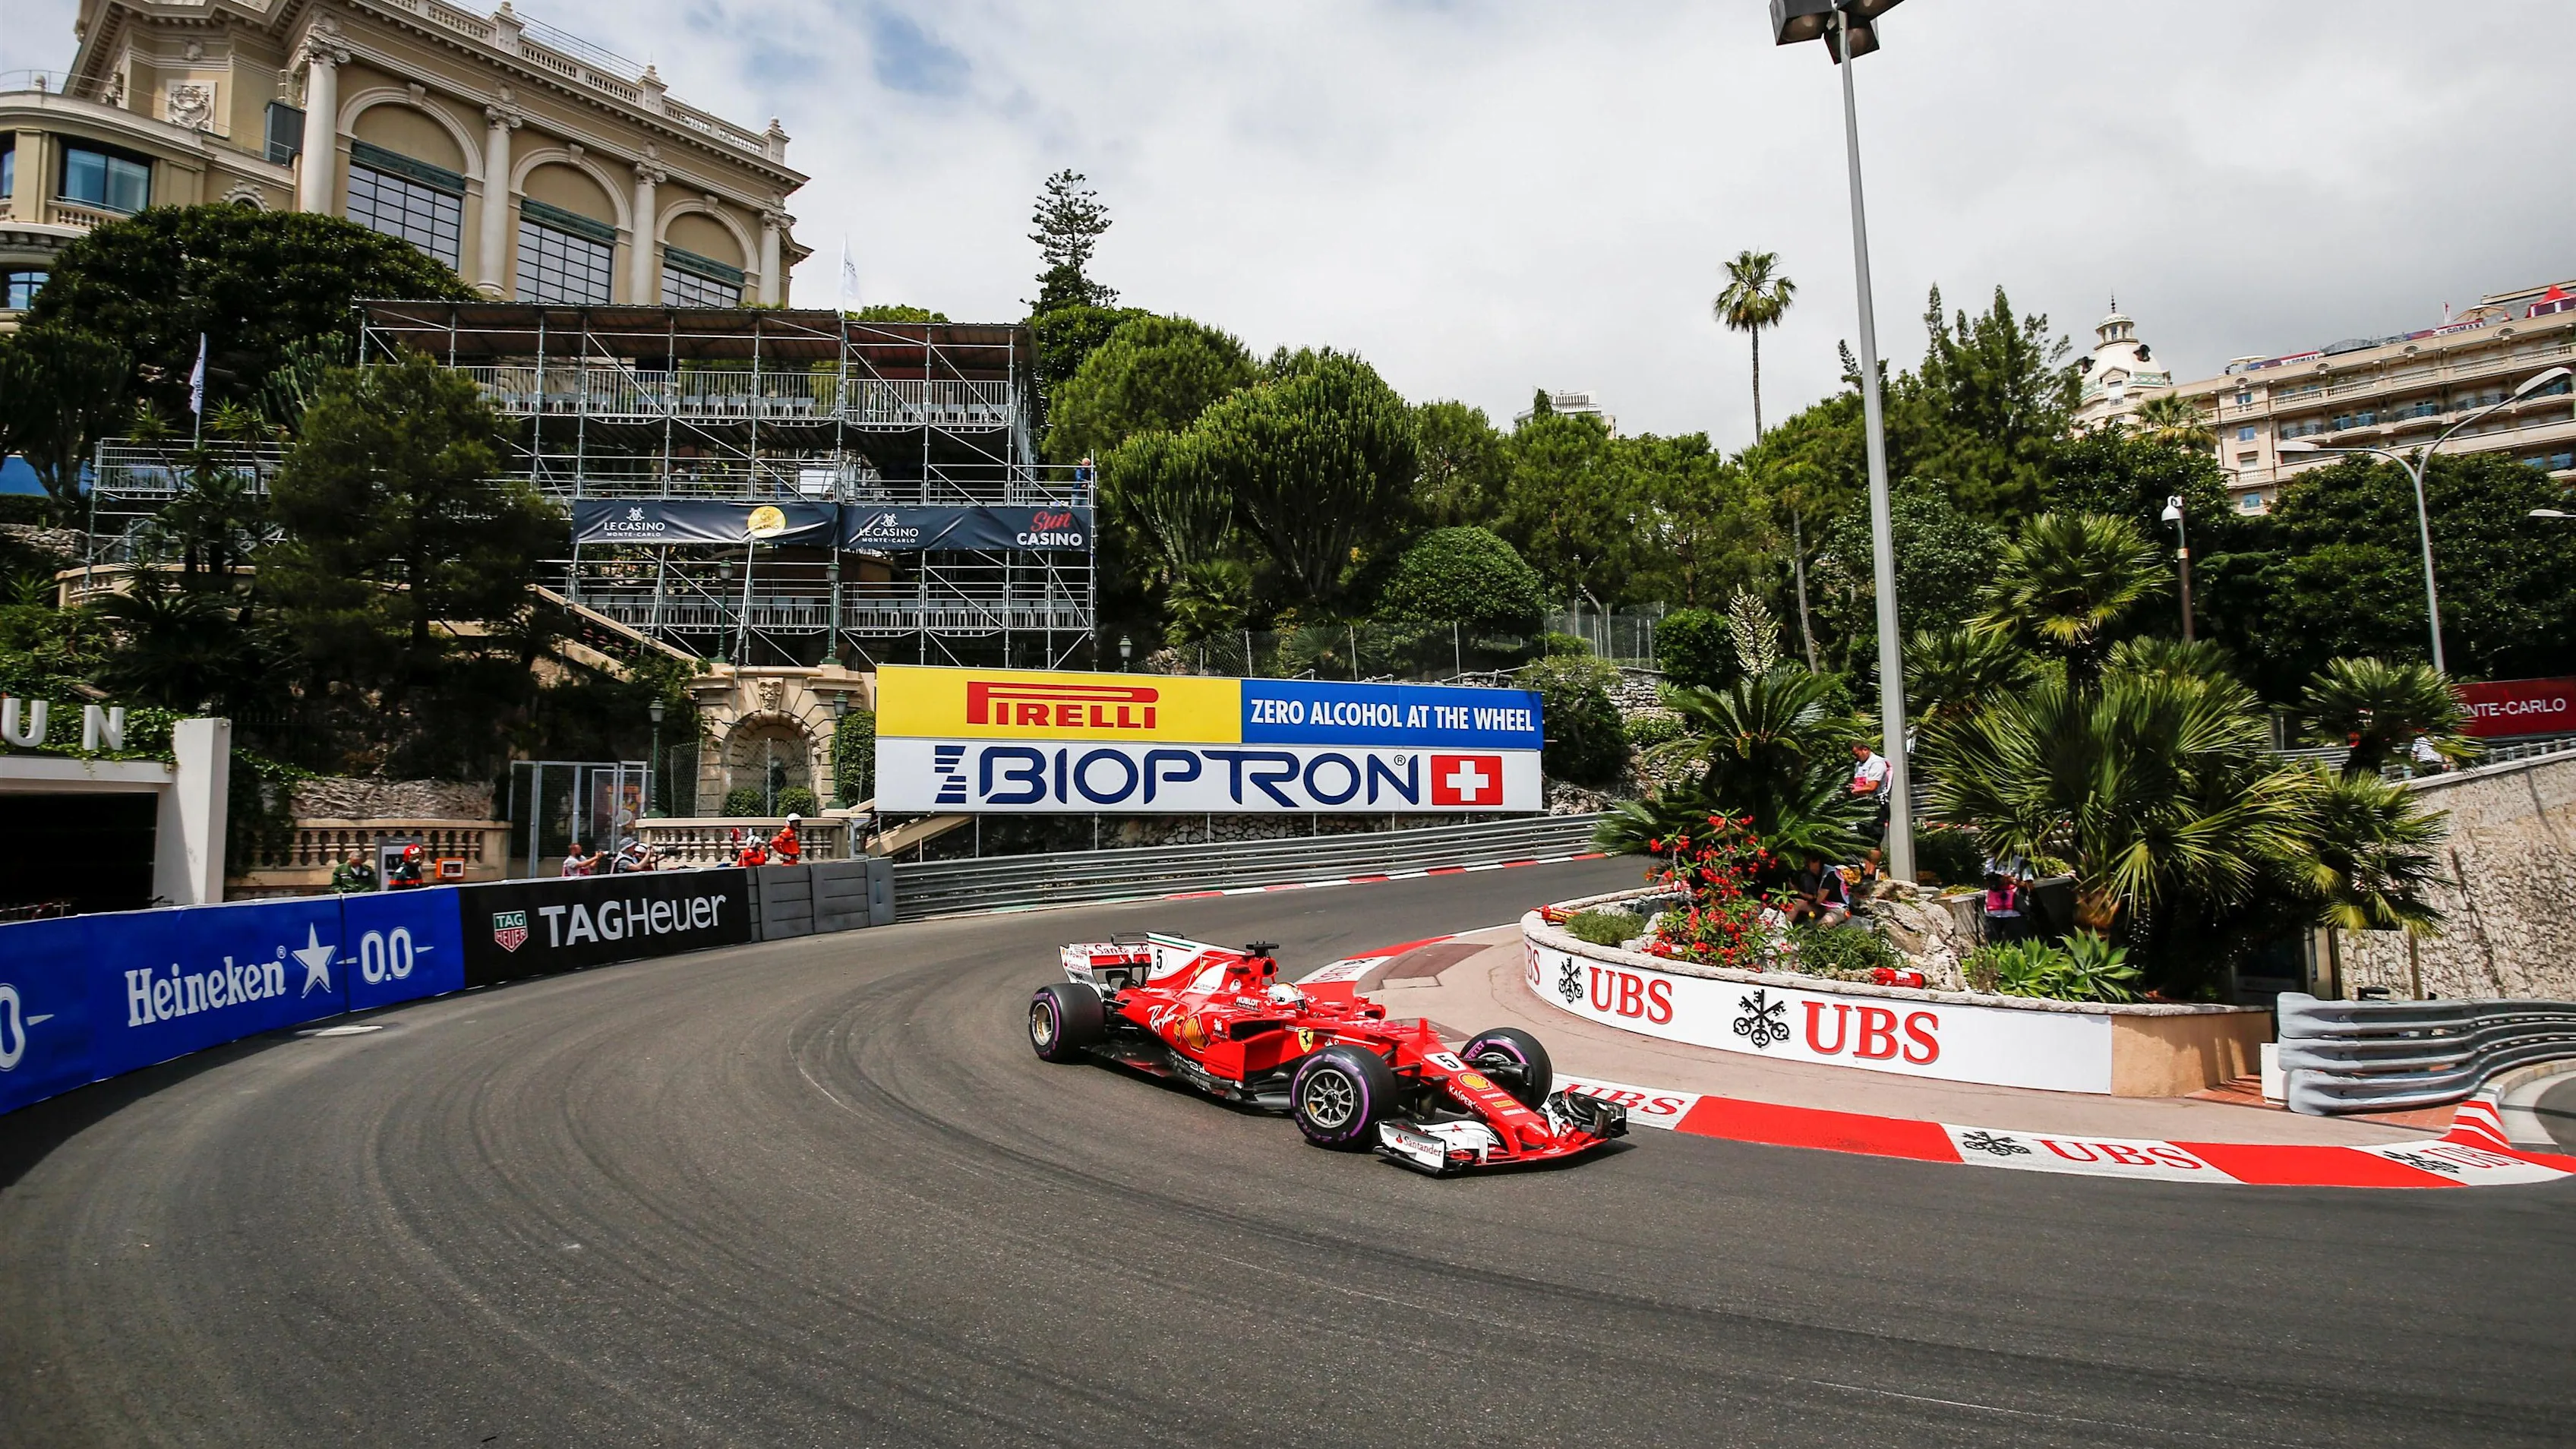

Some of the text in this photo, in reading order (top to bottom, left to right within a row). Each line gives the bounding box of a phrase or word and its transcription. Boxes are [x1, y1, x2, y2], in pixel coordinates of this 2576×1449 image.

[604, 522, 666, 531] LE CASINO
[1031, 510, 1072, 532] Sun
[859, 527, 919, 537] LE CASINO
[1016, 532, 1083, 546] CASINO
[967, 681, 1159, 729] PIRELLI
[1250, 699, 1535, 731] ZERO ALCOHOL AT THE WHEEL
[2454, 698, 2566, 717] ONTE-CARLO
[496, 914, 524, 927] TAG
[497, 929, 526, 949] HEUER
[1157, 949, 1163, 970] 5
[1526, 943, 1540, 986] BS
[1236, 996, 1261, 1007] HUBLOT
[1589, 967, 1673, 1024] UBS
[1801, 1000, 1940, 1065] UBS
[1437, 1055, 1459, 1069] 5
[1404, 1136, 1442, 1157] Santander
[2032, 1139, 2202, 1170] UBS
[2418, 1147, 2525, 1169] UBS
